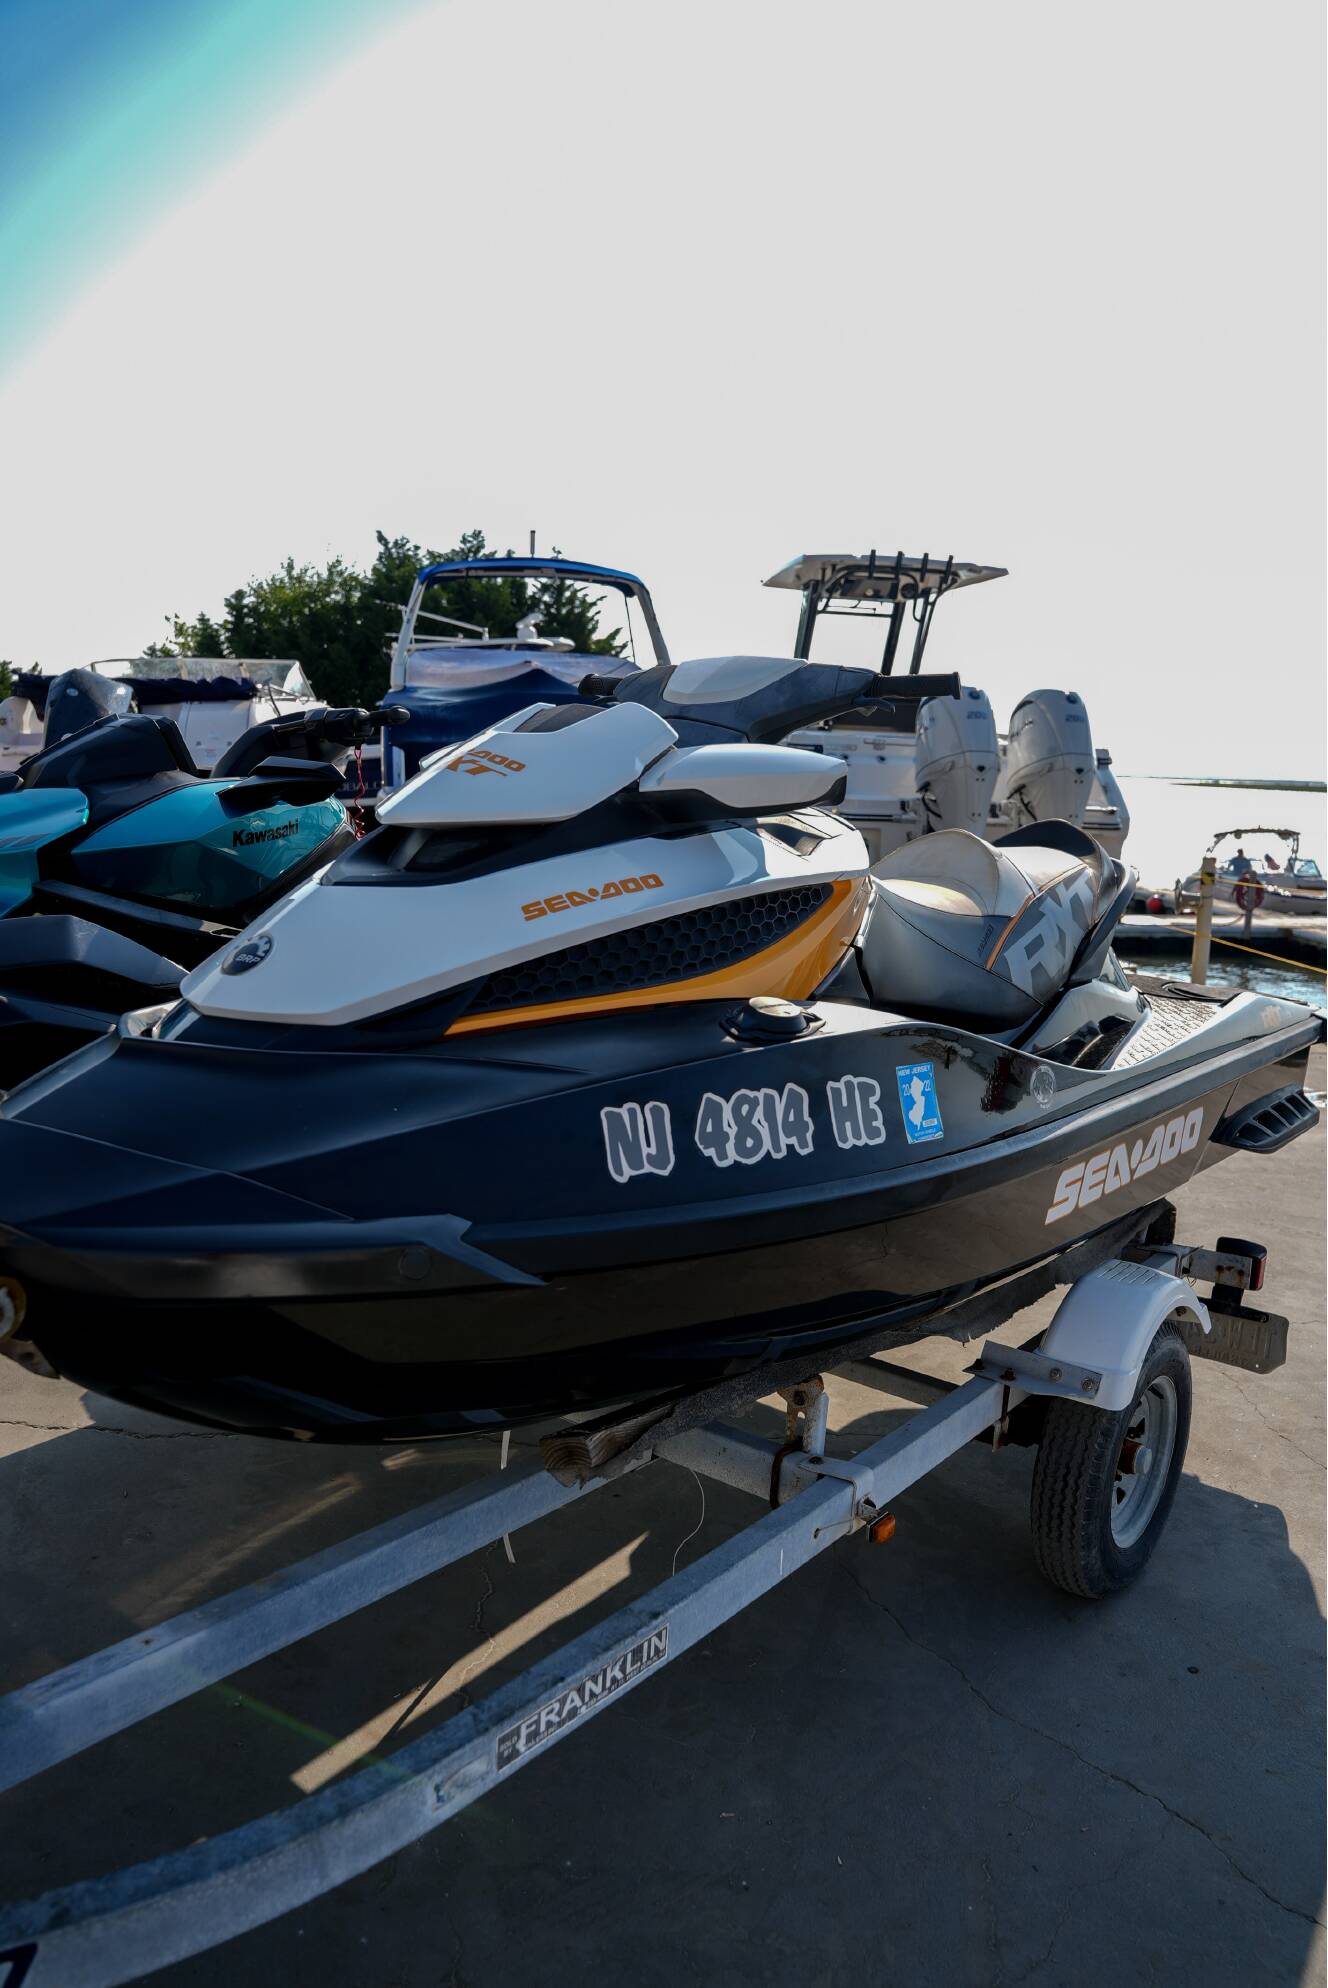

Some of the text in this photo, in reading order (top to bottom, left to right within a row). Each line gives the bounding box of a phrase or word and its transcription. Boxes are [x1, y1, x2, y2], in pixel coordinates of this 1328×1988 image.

[232, 817, 299, 847] Kawasaki
[236, 953, 261, 964] BRP
[600, 1074, 887, 1183] NJ 4814 HE
[516, 1629, 667, 1752] FRANKLIN
